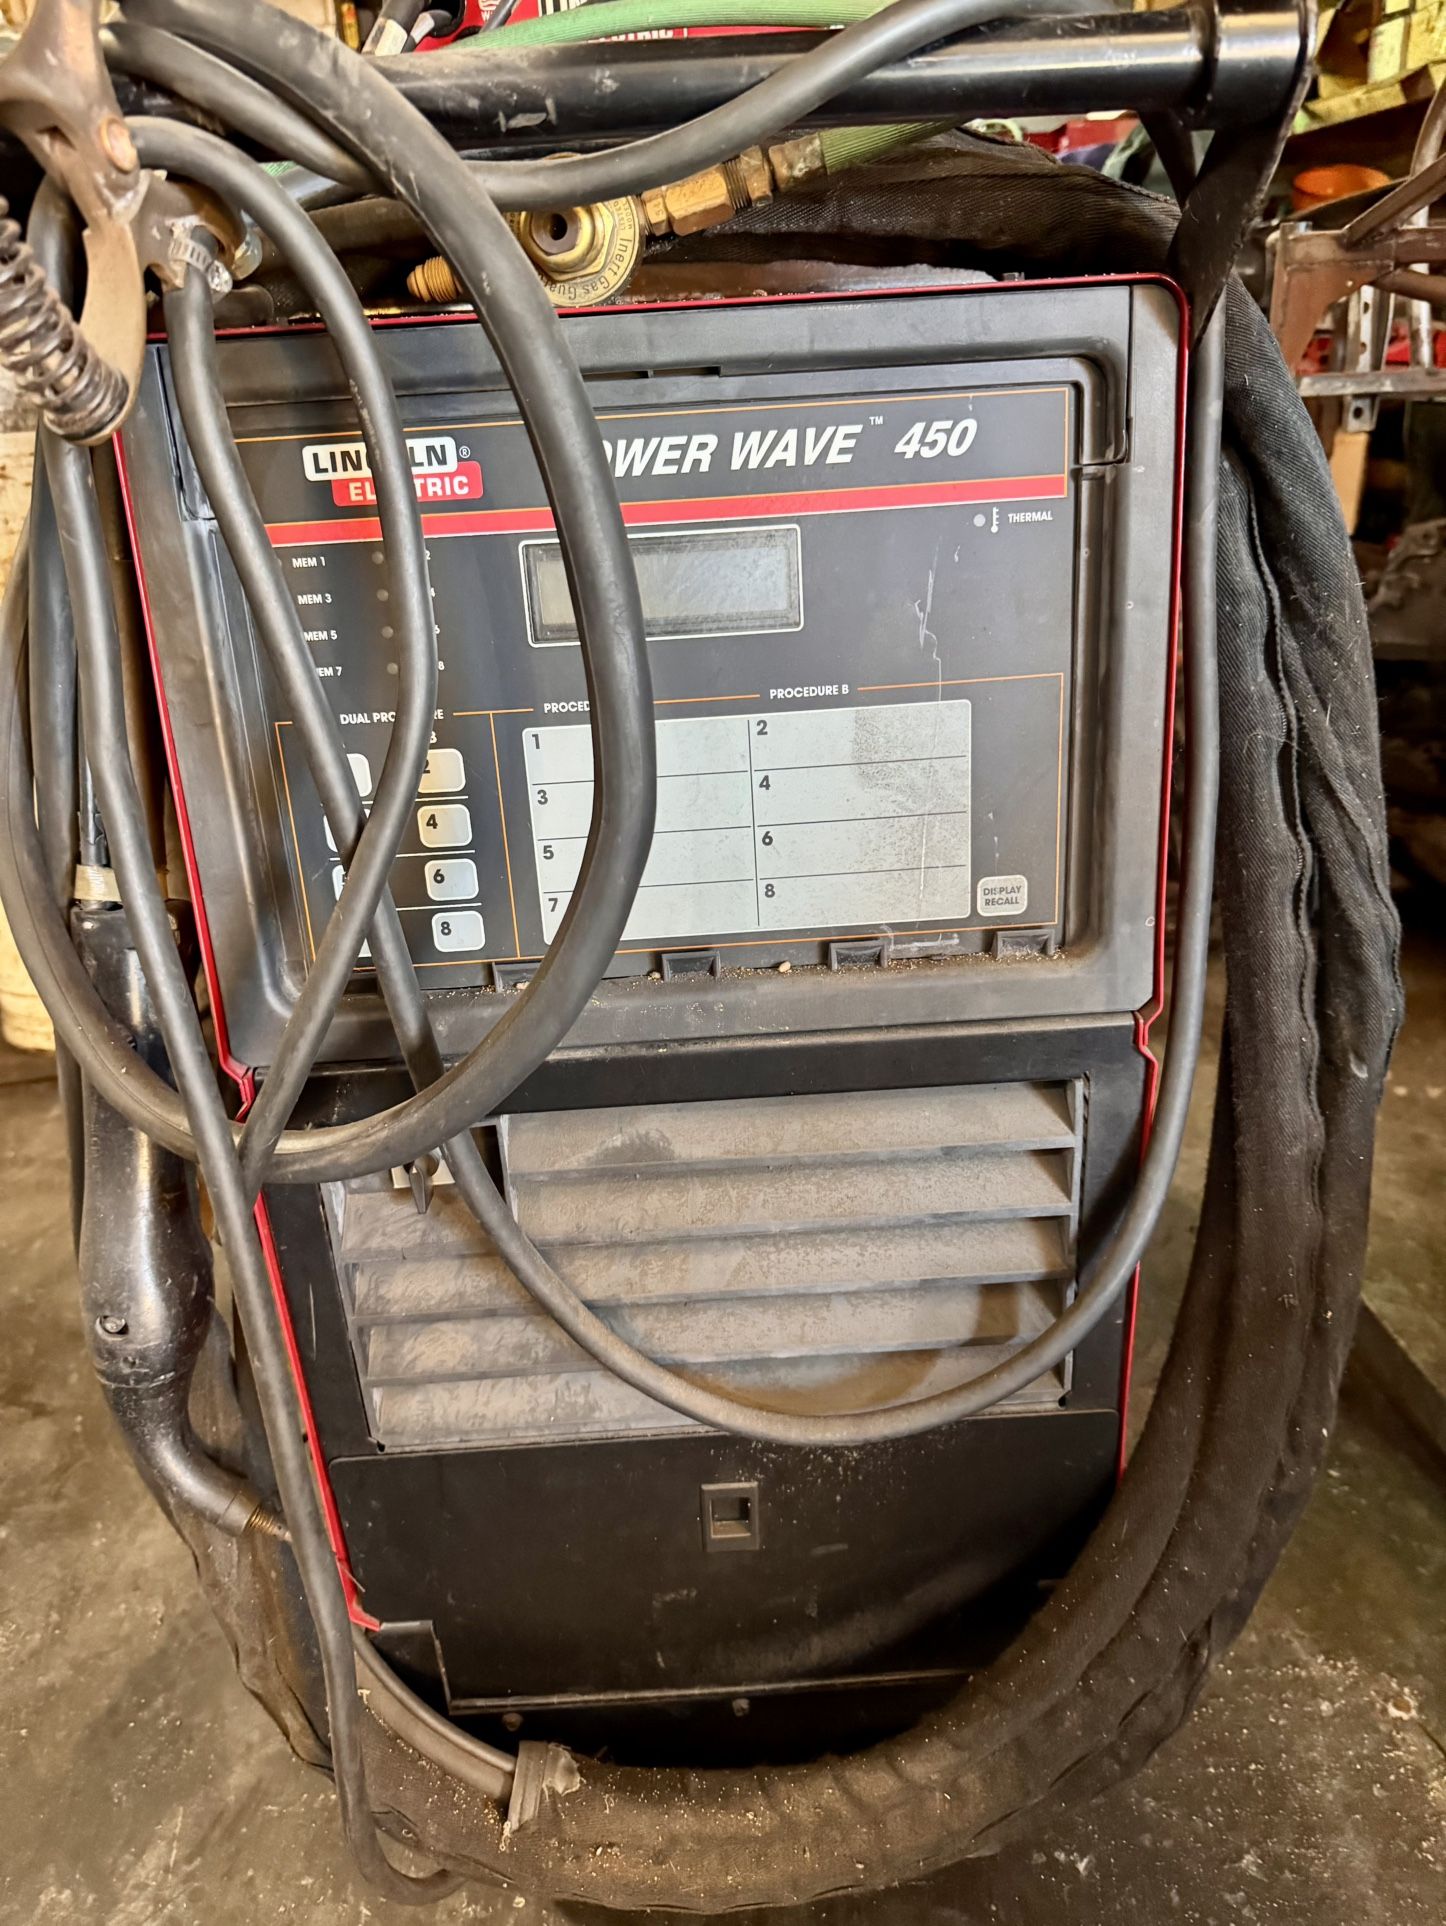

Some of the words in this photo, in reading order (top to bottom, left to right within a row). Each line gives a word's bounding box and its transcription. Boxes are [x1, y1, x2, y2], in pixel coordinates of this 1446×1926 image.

[608, 238, 632, 276] Inert
[584, 278, 610, 295] Gas
[730, 424, 863, 470] WAVE
[894, 418, 977, 459] 450
[312, 444, 447, 474] LINLN
[349, 475, 469, 501] ELTRIC
[1008, 511, 1053, 523] THERMAL
[292, 557, 317, 568] MEM
[320, 556, 326, 567] 1
[297, 594, 323, 605] MEM
[325, 593, 332, 603] 3
[304, 631, 328, 641] MEM
[330, 630, 337, 640] 5
[336, 666, 342, 676] 7
[438, 661, 445, 671] 8
[770, 685, 839, 699] PROCEDURE
[841, 684, 849, 695] B
[340, 713, 370, 725] DUAL
[756, 720, 768, 735] 2
[532, 734, 540, 750] 1
[759, 775, 771, 790] 4
[537, 790, 548, 805] 3
[426, 814, 438, 829] 4
[762, 831, 774, 846] 6
[543, 845, 554, 860] 5
[433, 868, 445, 884] 6
[764, 884, 776, 898] 8
[983, 885, 1021, 896] DISPLAY
[548, 898, 558, 912] 7
[985, 897, 1019, 906] RECALL
[440, 921, 452, 936] 8
